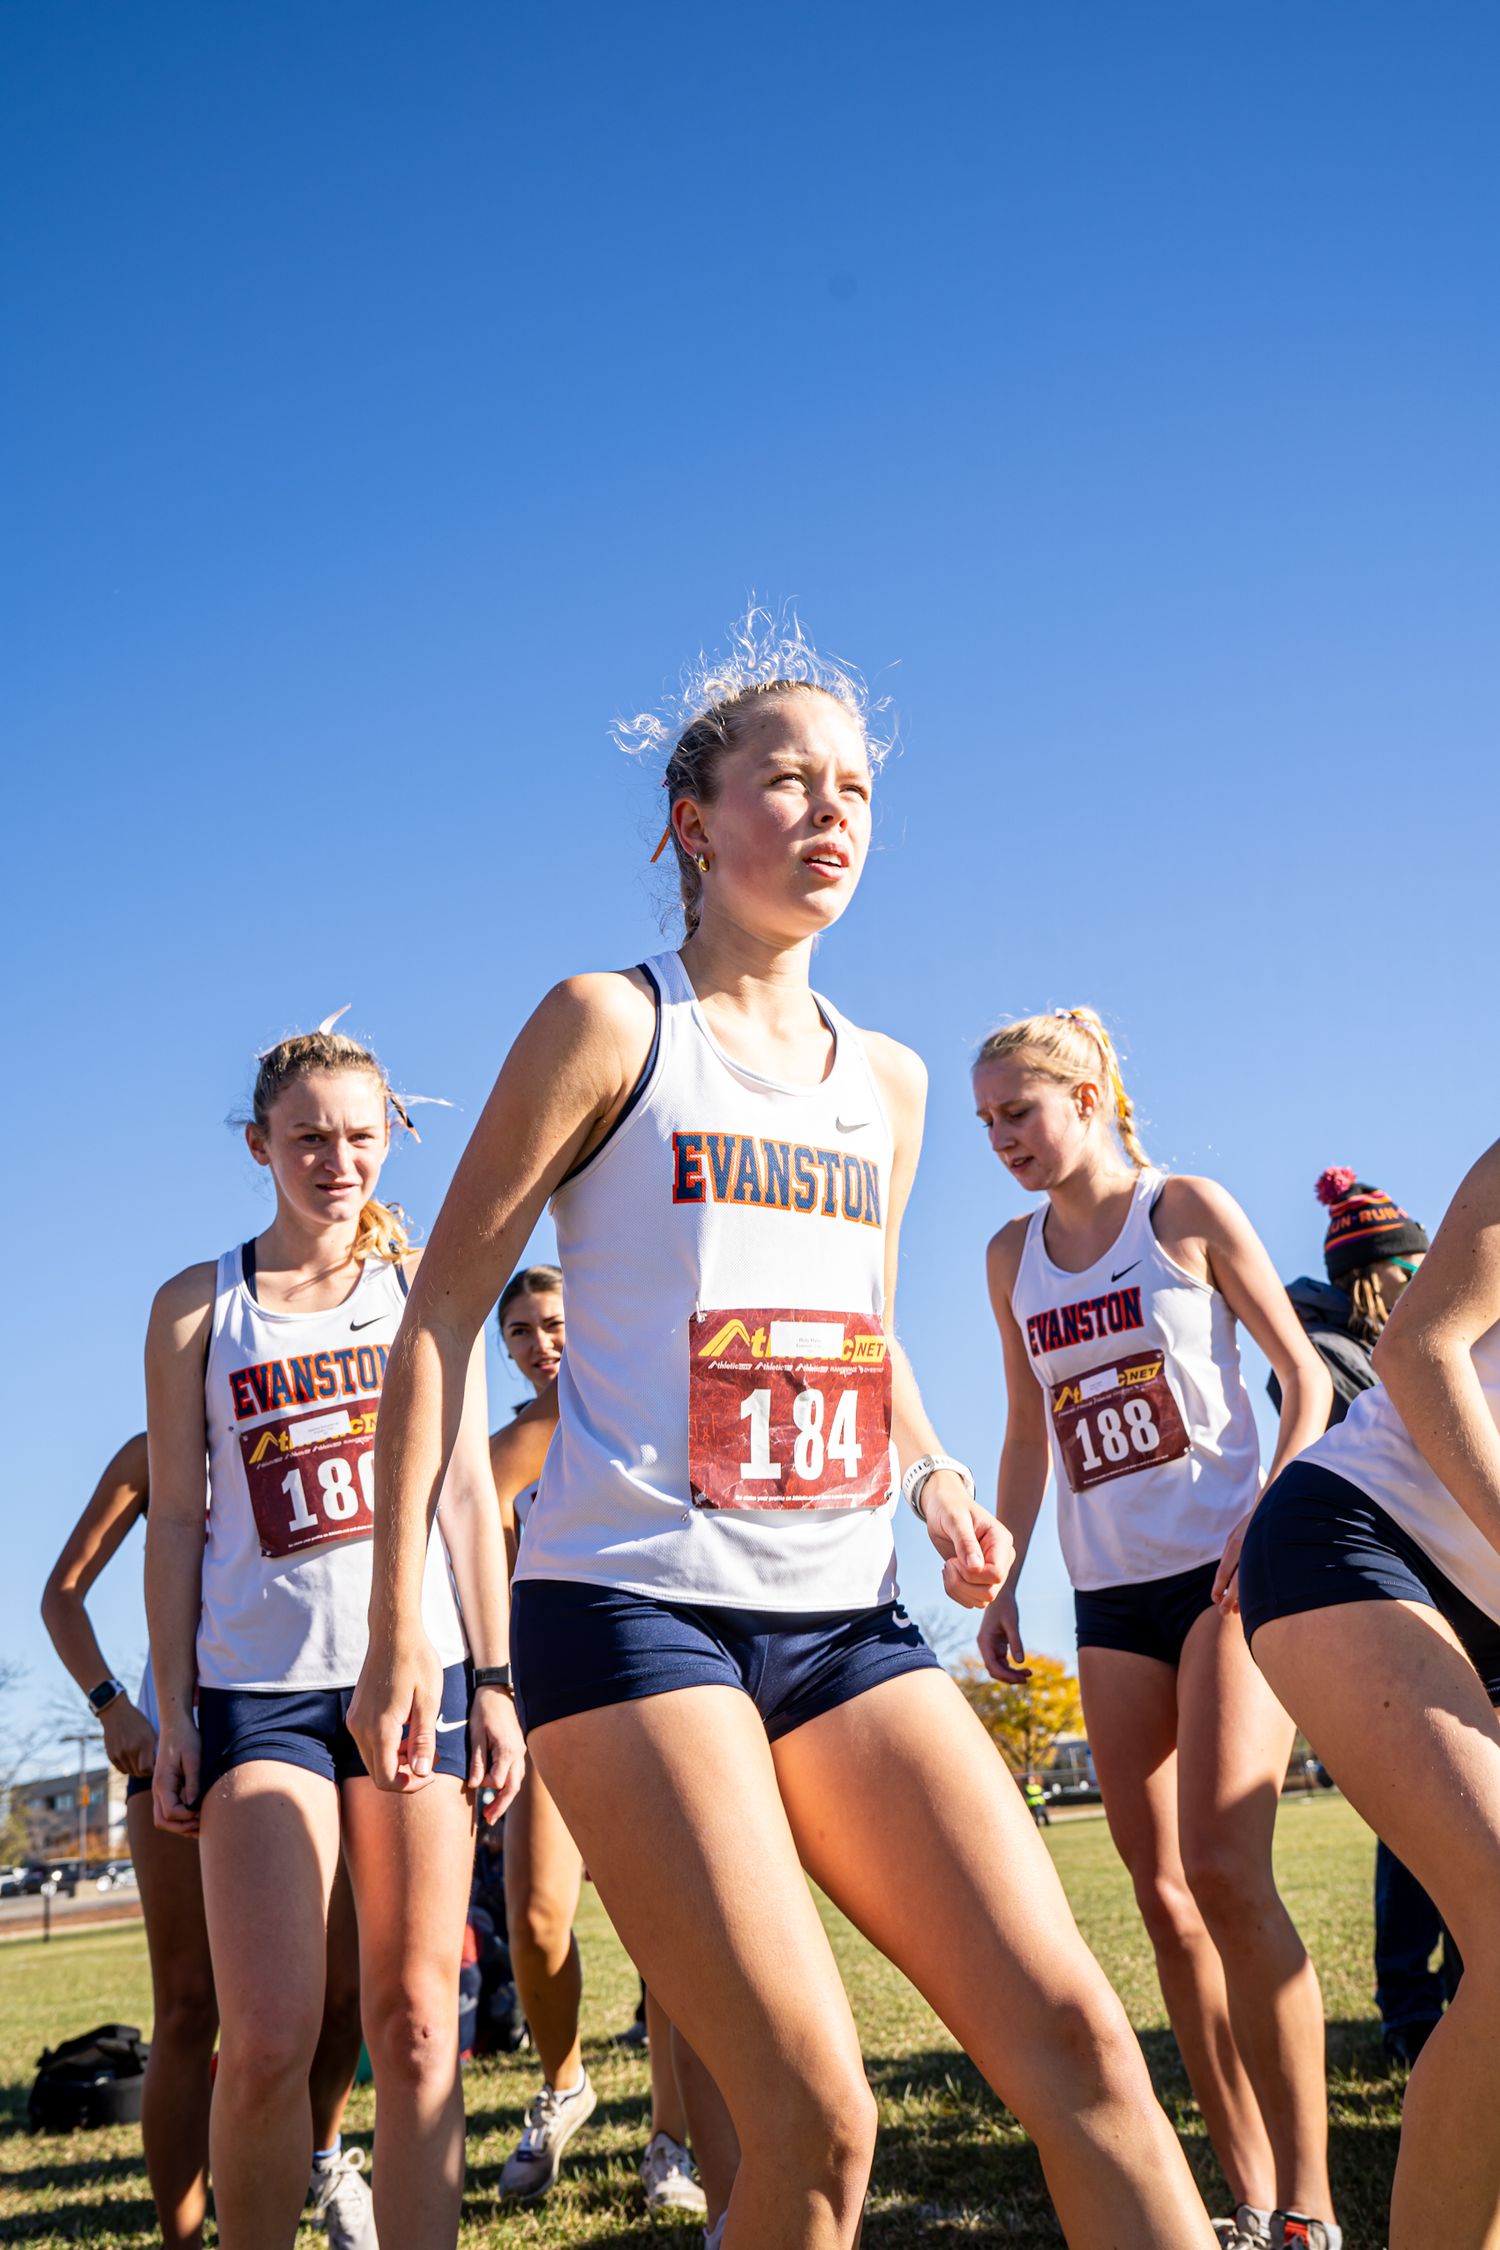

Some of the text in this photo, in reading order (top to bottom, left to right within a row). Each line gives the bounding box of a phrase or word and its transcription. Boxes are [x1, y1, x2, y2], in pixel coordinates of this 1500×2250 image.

[672, 1132, 882, 1229] EVANSTON
[857, 1342, 884, 1357] NET
[1026, 1286, 1144, 1358] EVANSTON
[1129, 1367, 1156, 1380] NET
[740, 1388, 863, 1480] 184
[1075, 1398, 1160, 1472] 188
